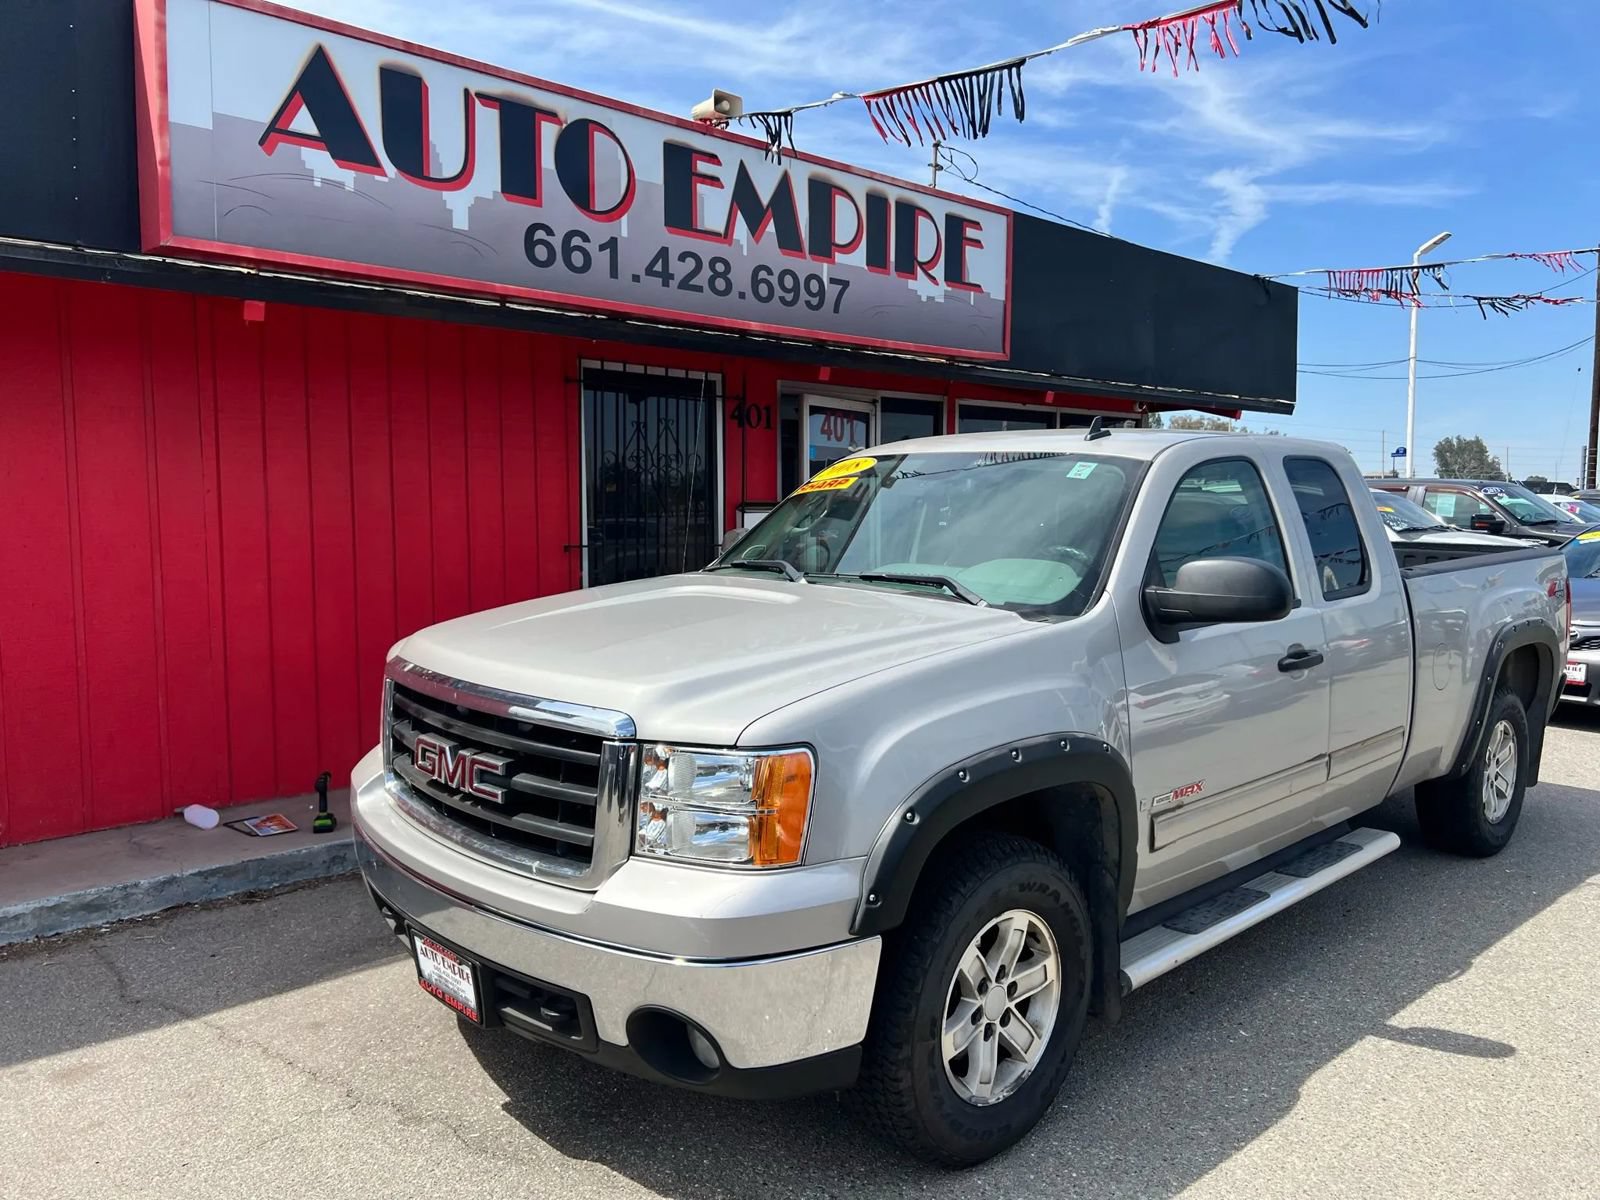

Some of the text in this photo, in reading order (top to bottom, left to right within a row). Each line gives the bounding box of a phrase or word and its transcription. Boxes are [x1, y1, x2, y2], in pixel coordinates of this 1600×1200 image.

[259, 43, 984, 293] AUTO EMPIRE
[524, 222, 850, 314] 661.428.6997
[730, 398, 773, 430] 401
[820, 411, 857, 443] 401
[415, 733, 508, 804] GMC
[420, 980, 443, 998] AUTO
[445, 994, 478, 1022] EMPIRE
